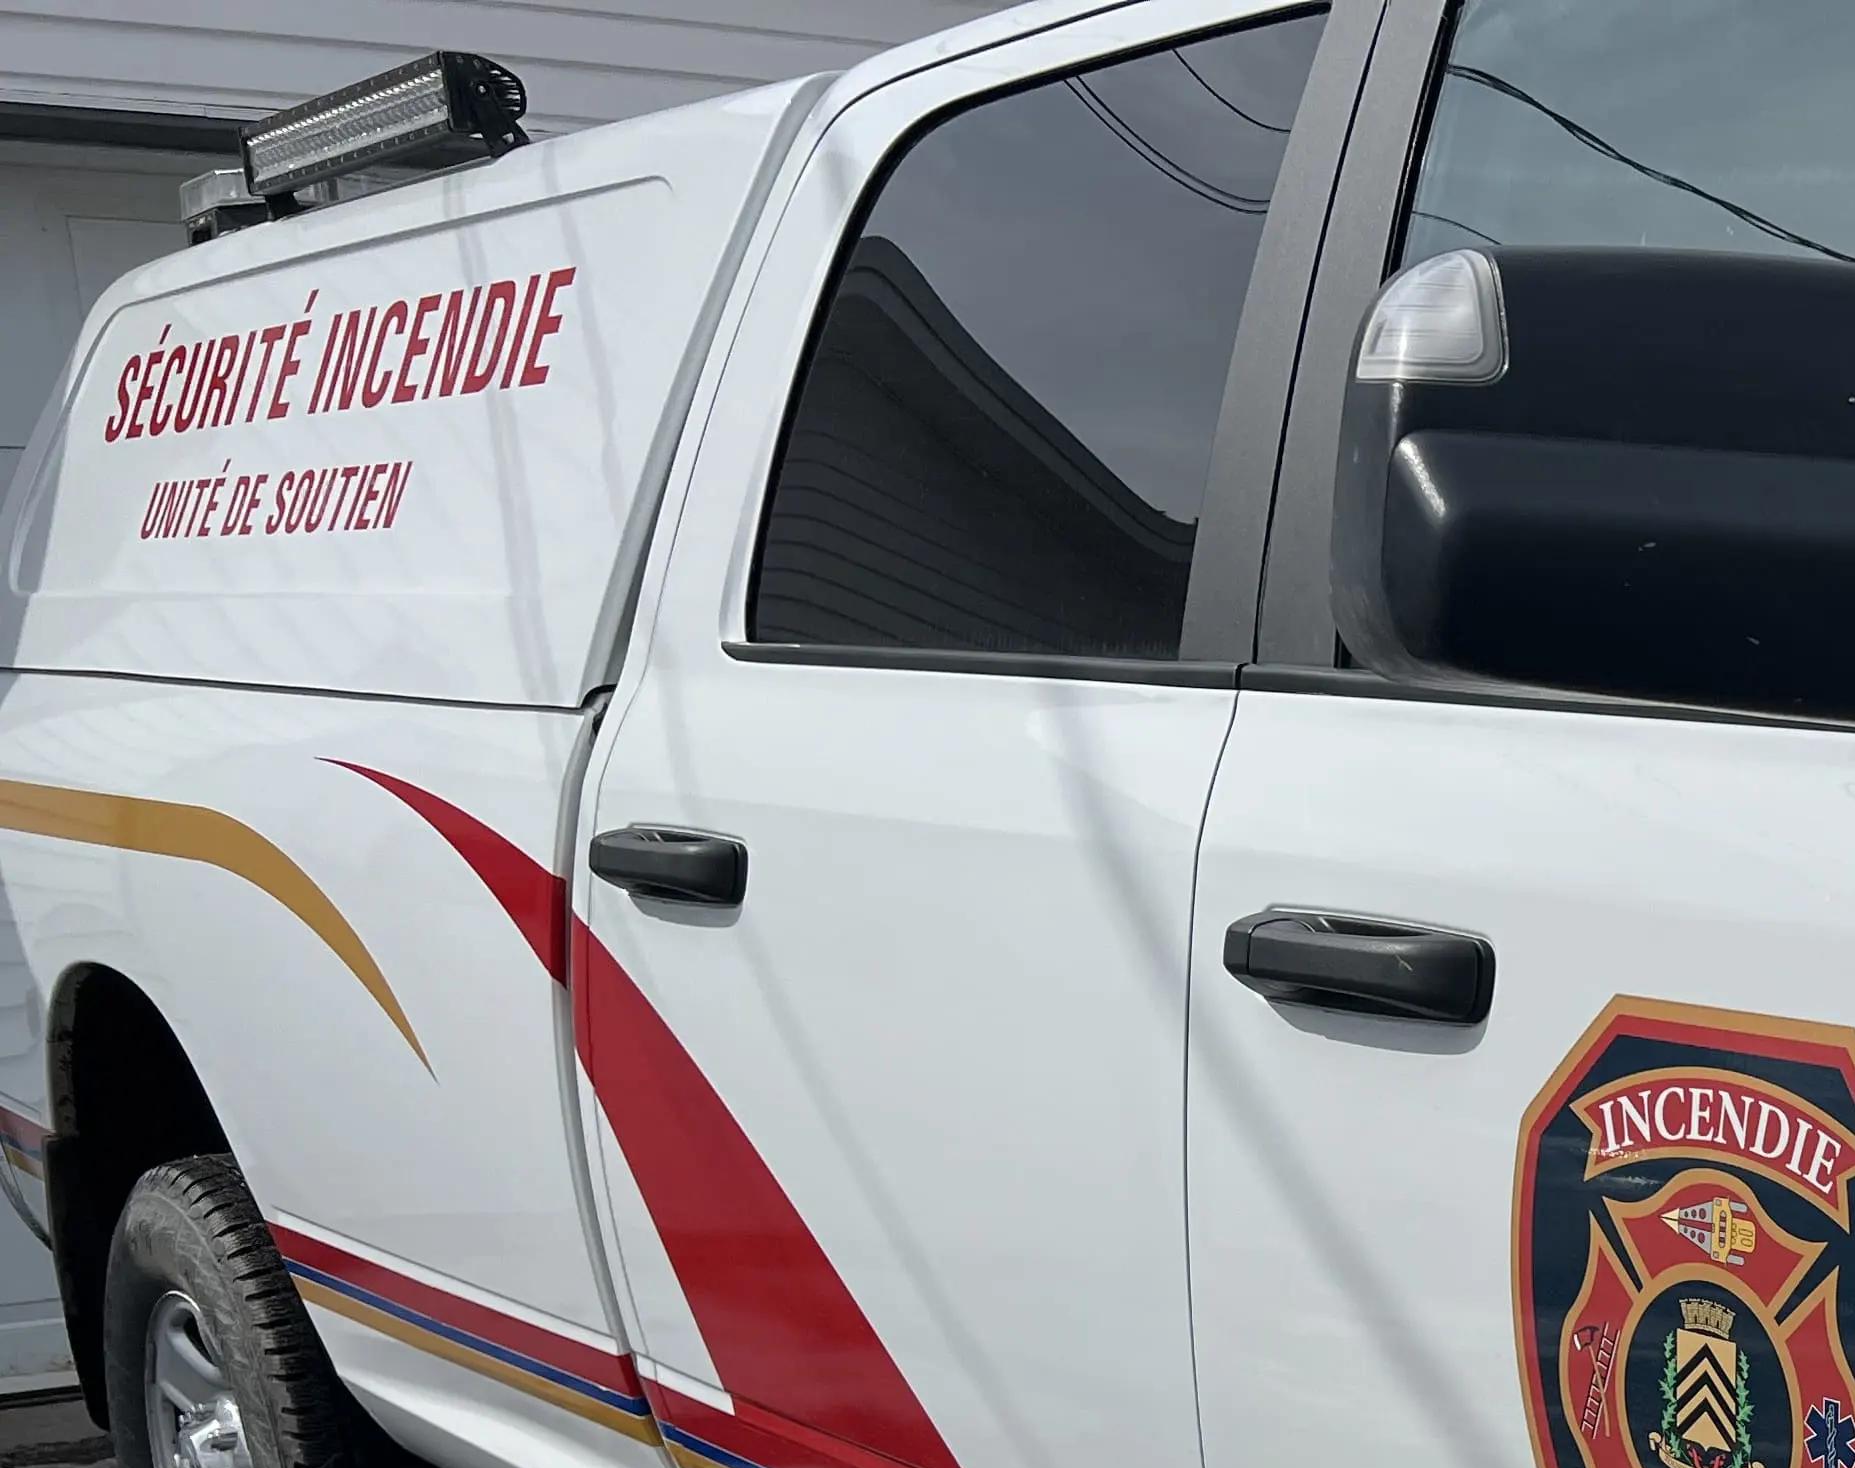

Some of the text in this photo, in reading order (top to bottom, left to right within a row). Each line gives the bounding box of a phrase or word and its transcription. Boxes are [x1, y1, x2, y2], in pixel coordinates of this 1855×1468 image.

[104, 267, 577, 443] SÉCURITÉ INCENDIE
[140, 458, 414, 541] UNITÉ DE SOUTIEN
[1599, 1086, 1842, 1194] INCENDIE
